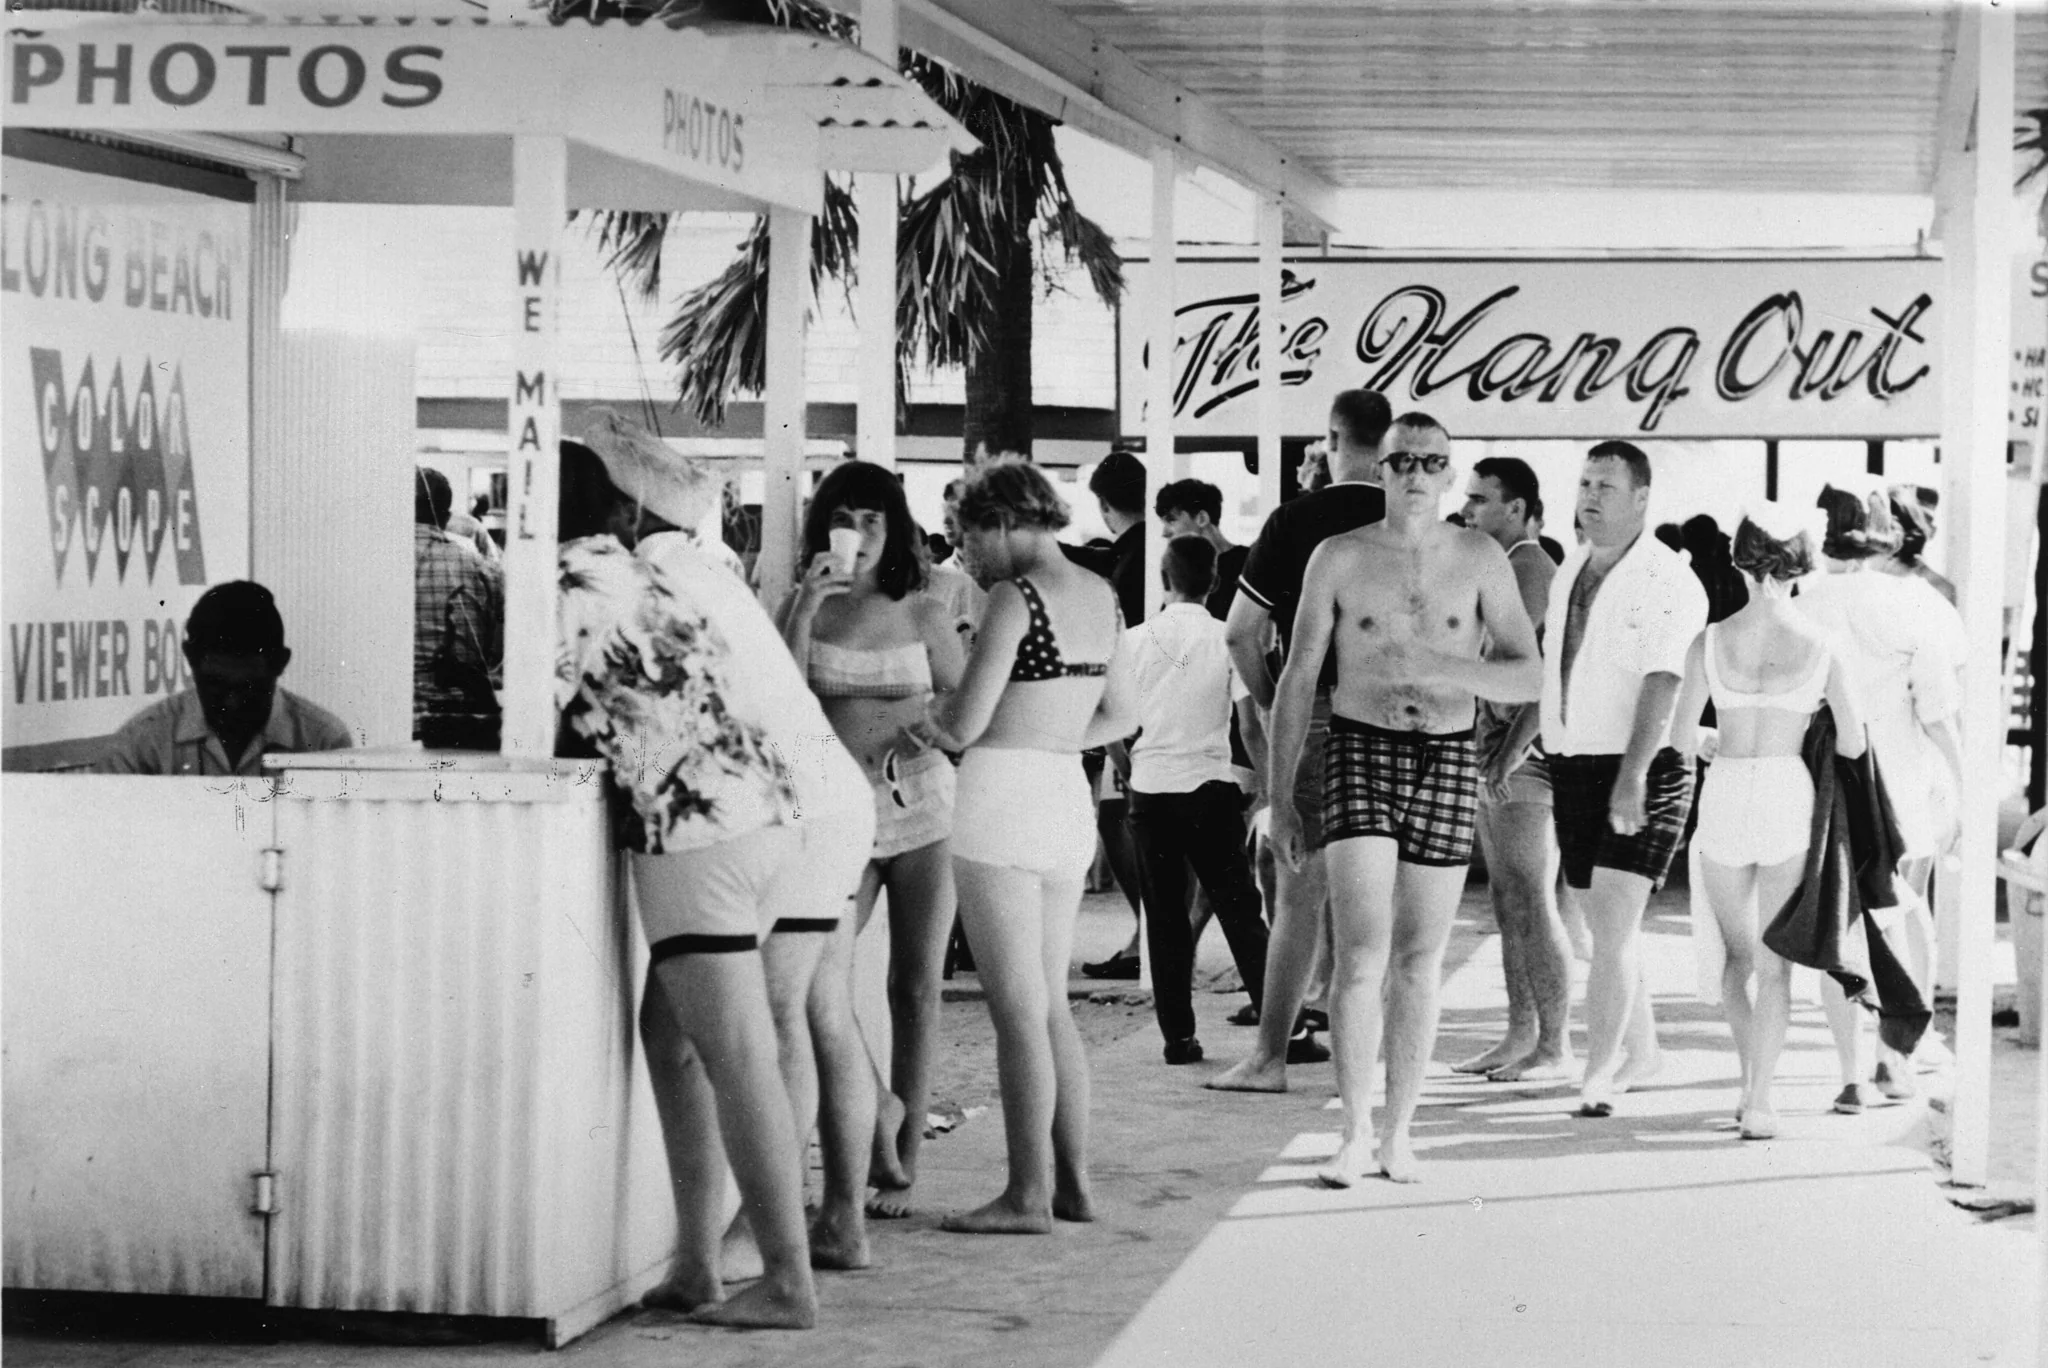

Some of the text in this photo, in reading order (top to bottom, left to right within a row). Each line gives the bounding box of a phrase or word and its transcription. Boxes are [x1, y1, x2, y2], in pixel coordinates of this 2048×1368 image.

[11, 42, 445, 107] PHOTOS
[663, 87, 744, 174] PHOTOS
[0, 193, 232, 320] LONG BEACH
[1143, 268, 1933, 431] The Hang Out
[43, 381, 187, 456] COLOR
[515, 249, 549, 540] WE MAIL
[54, 484, 192, 553] SCOPE
[9, 619, 131, 705] VIEWER
